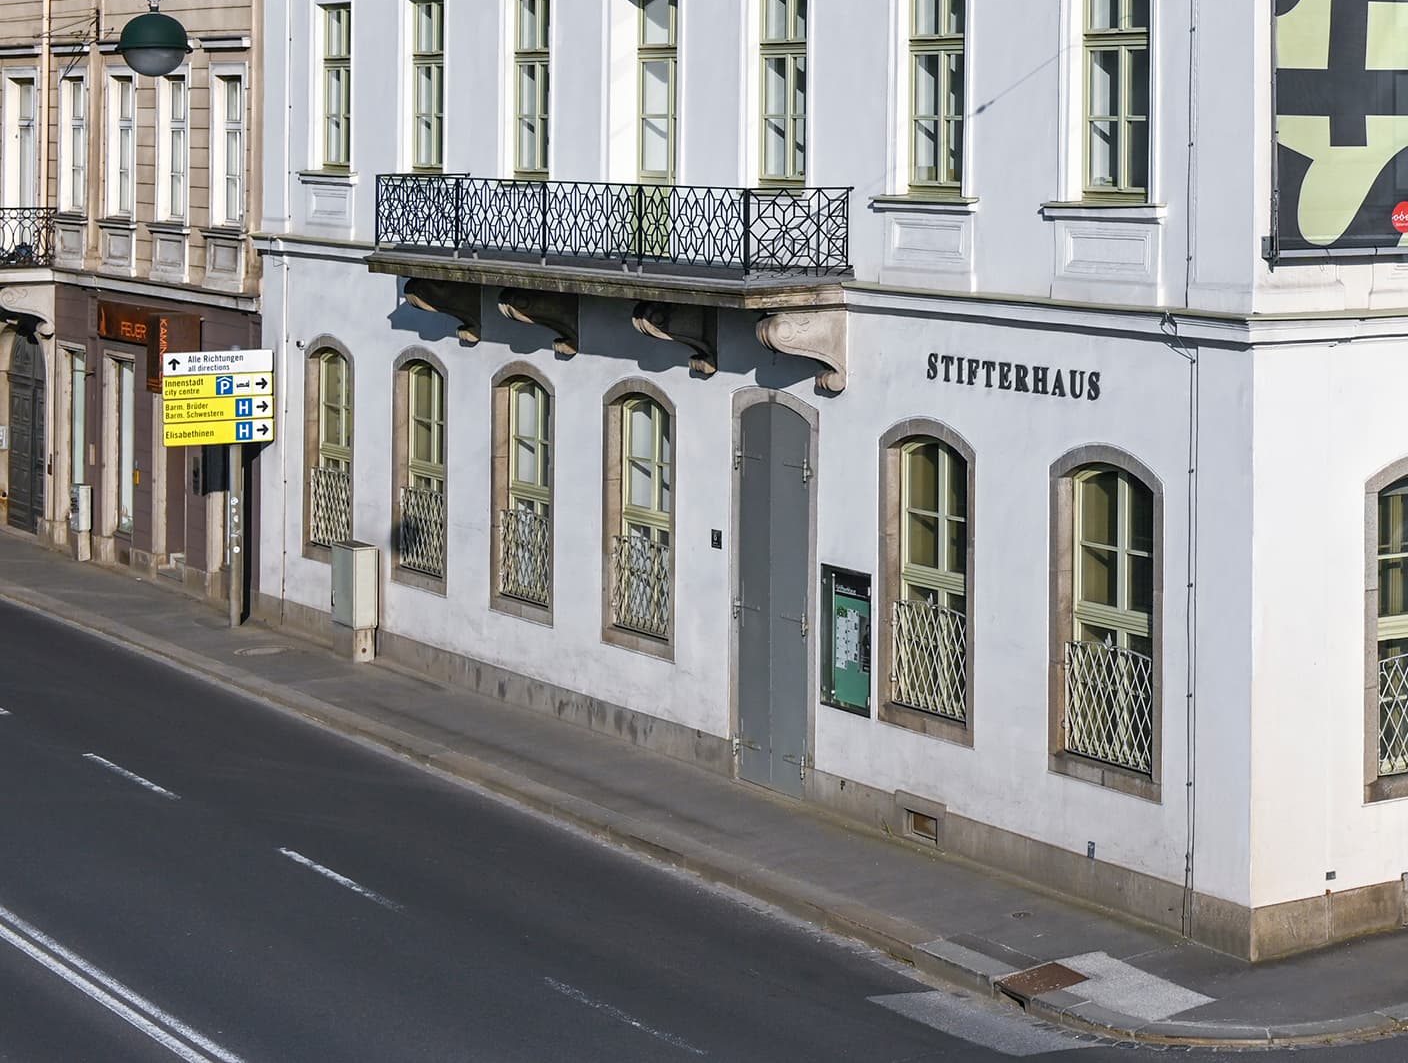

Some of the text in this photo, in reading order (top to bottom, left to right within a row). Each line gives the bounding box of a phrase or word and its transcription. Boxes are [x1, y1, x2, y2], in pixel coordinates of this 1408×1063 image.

[188, 353, 244, 364] Alle Richtungen
[198, 364, 230, 372] directions
[926, 352, 1101, 401] STIFTERHAUS
[164, 378, 204, 387] Innenstadt
[164, 387, 200, 397] city centre
[165, 402, 208, 411] Barm. Brüder
[165, 410, 224, 419] Barm. Schwestern
[165, 430, 215, 440] Elisabethinen
